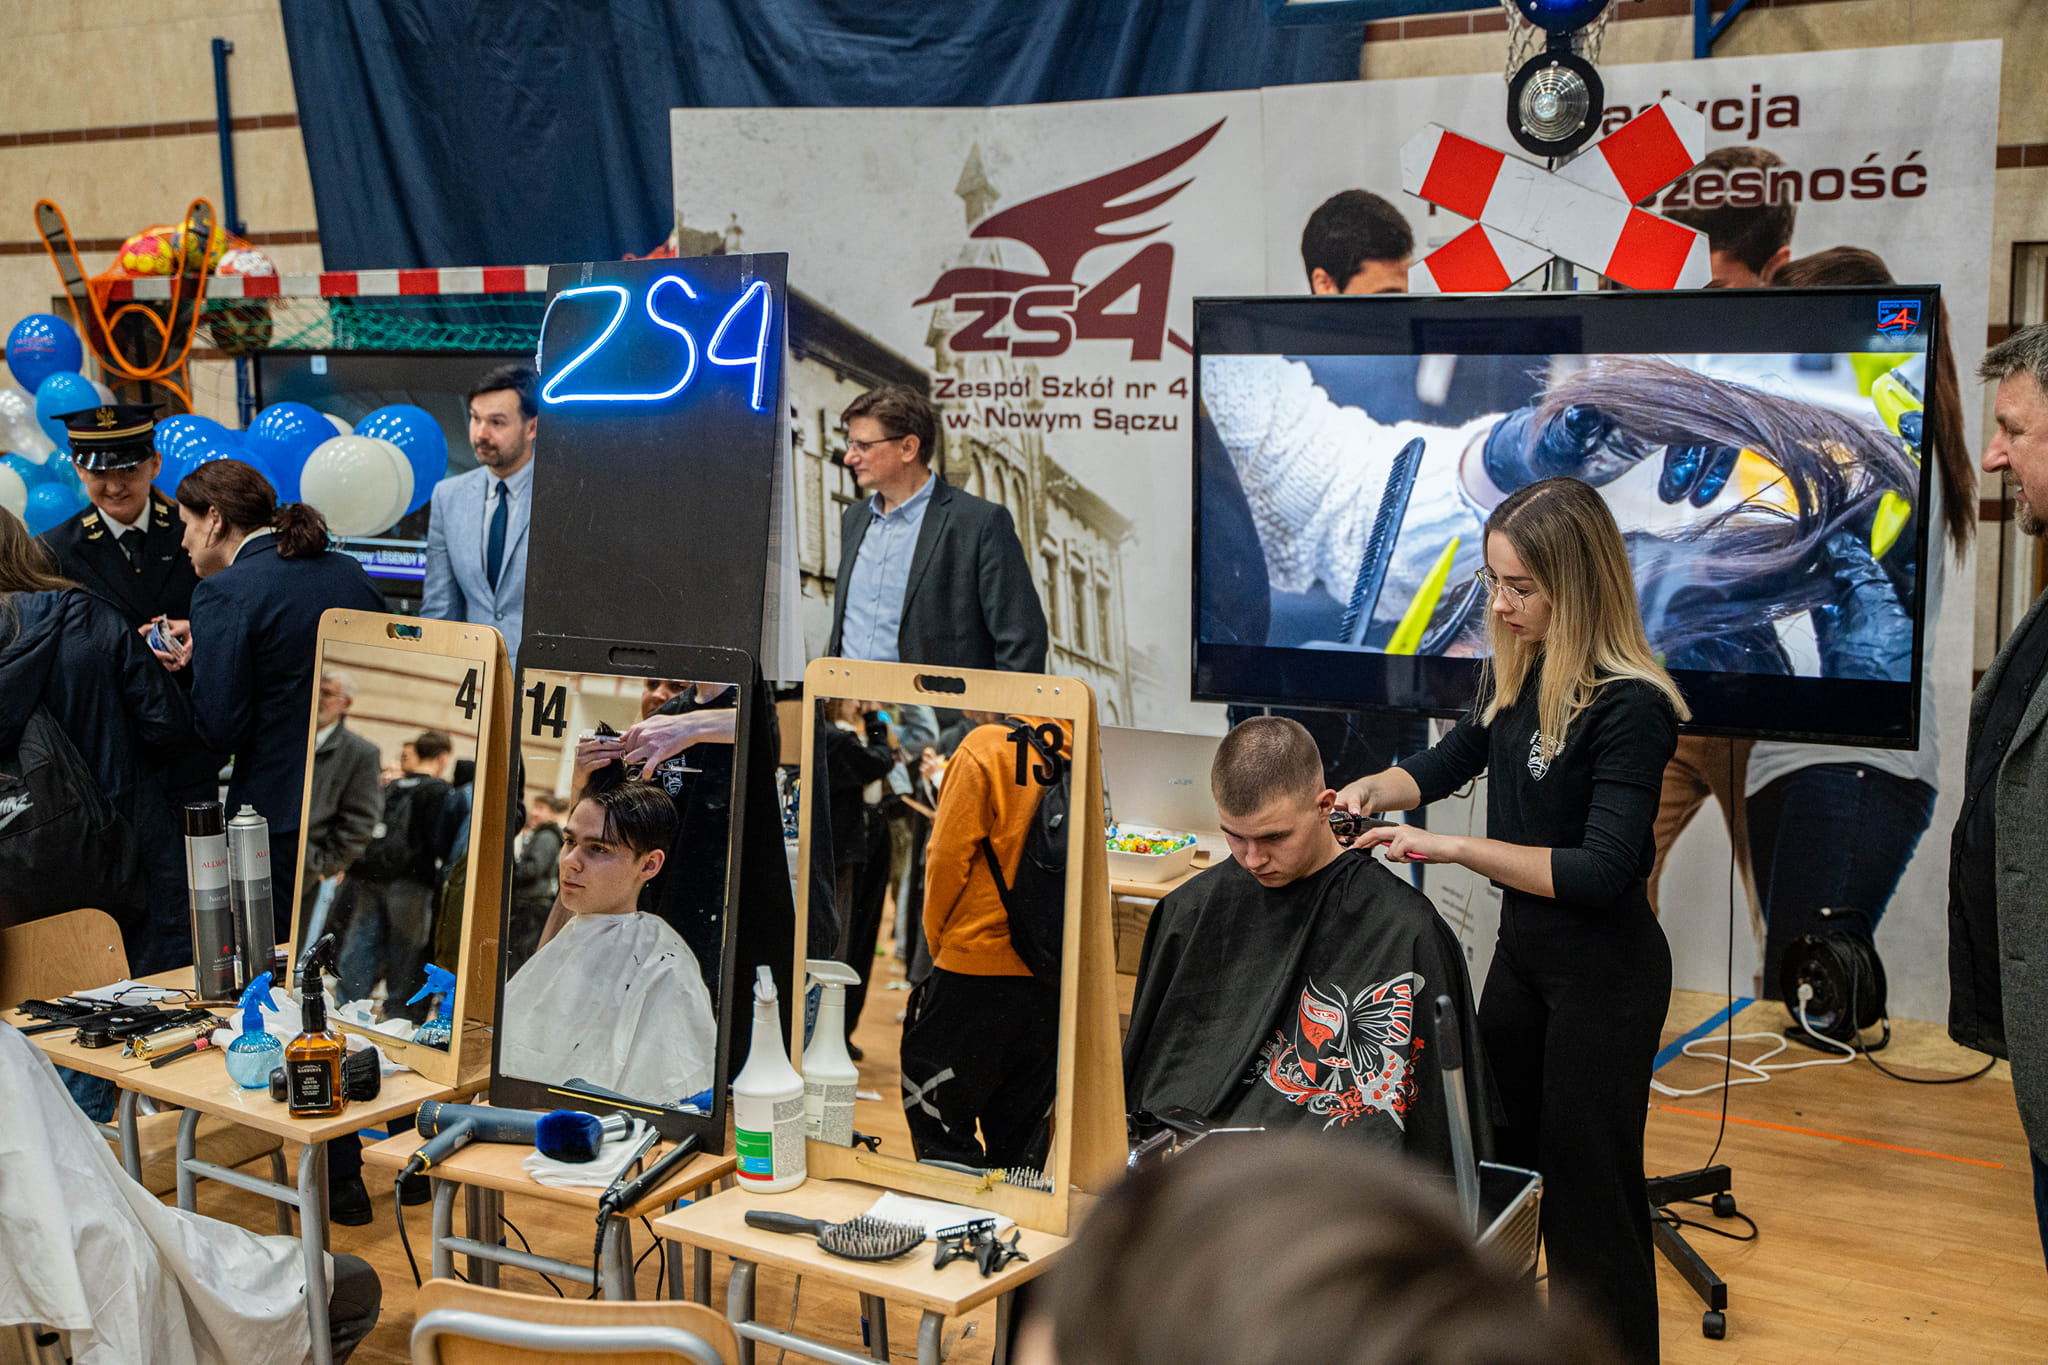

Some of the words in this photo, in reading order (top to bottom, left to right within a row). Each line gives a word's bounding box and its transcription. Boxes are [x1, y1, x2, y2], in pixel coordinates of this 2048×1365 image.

[934, 375, 1031, 401] Zespół
[1042, 375, 1114, 399] Szkół
[1126, 384, 1157, 399] nr
[1168, 376, 1189, 399] 4
[946, 414, 971, 429] w
[985, 408, 1082, 433] Nowym
[1093, 408, 1179, 435] Sączu
[455, 668, 478, 719] 4
[526, 681, 568, 738] 14
[1006, 722, 1064, 787] 13
